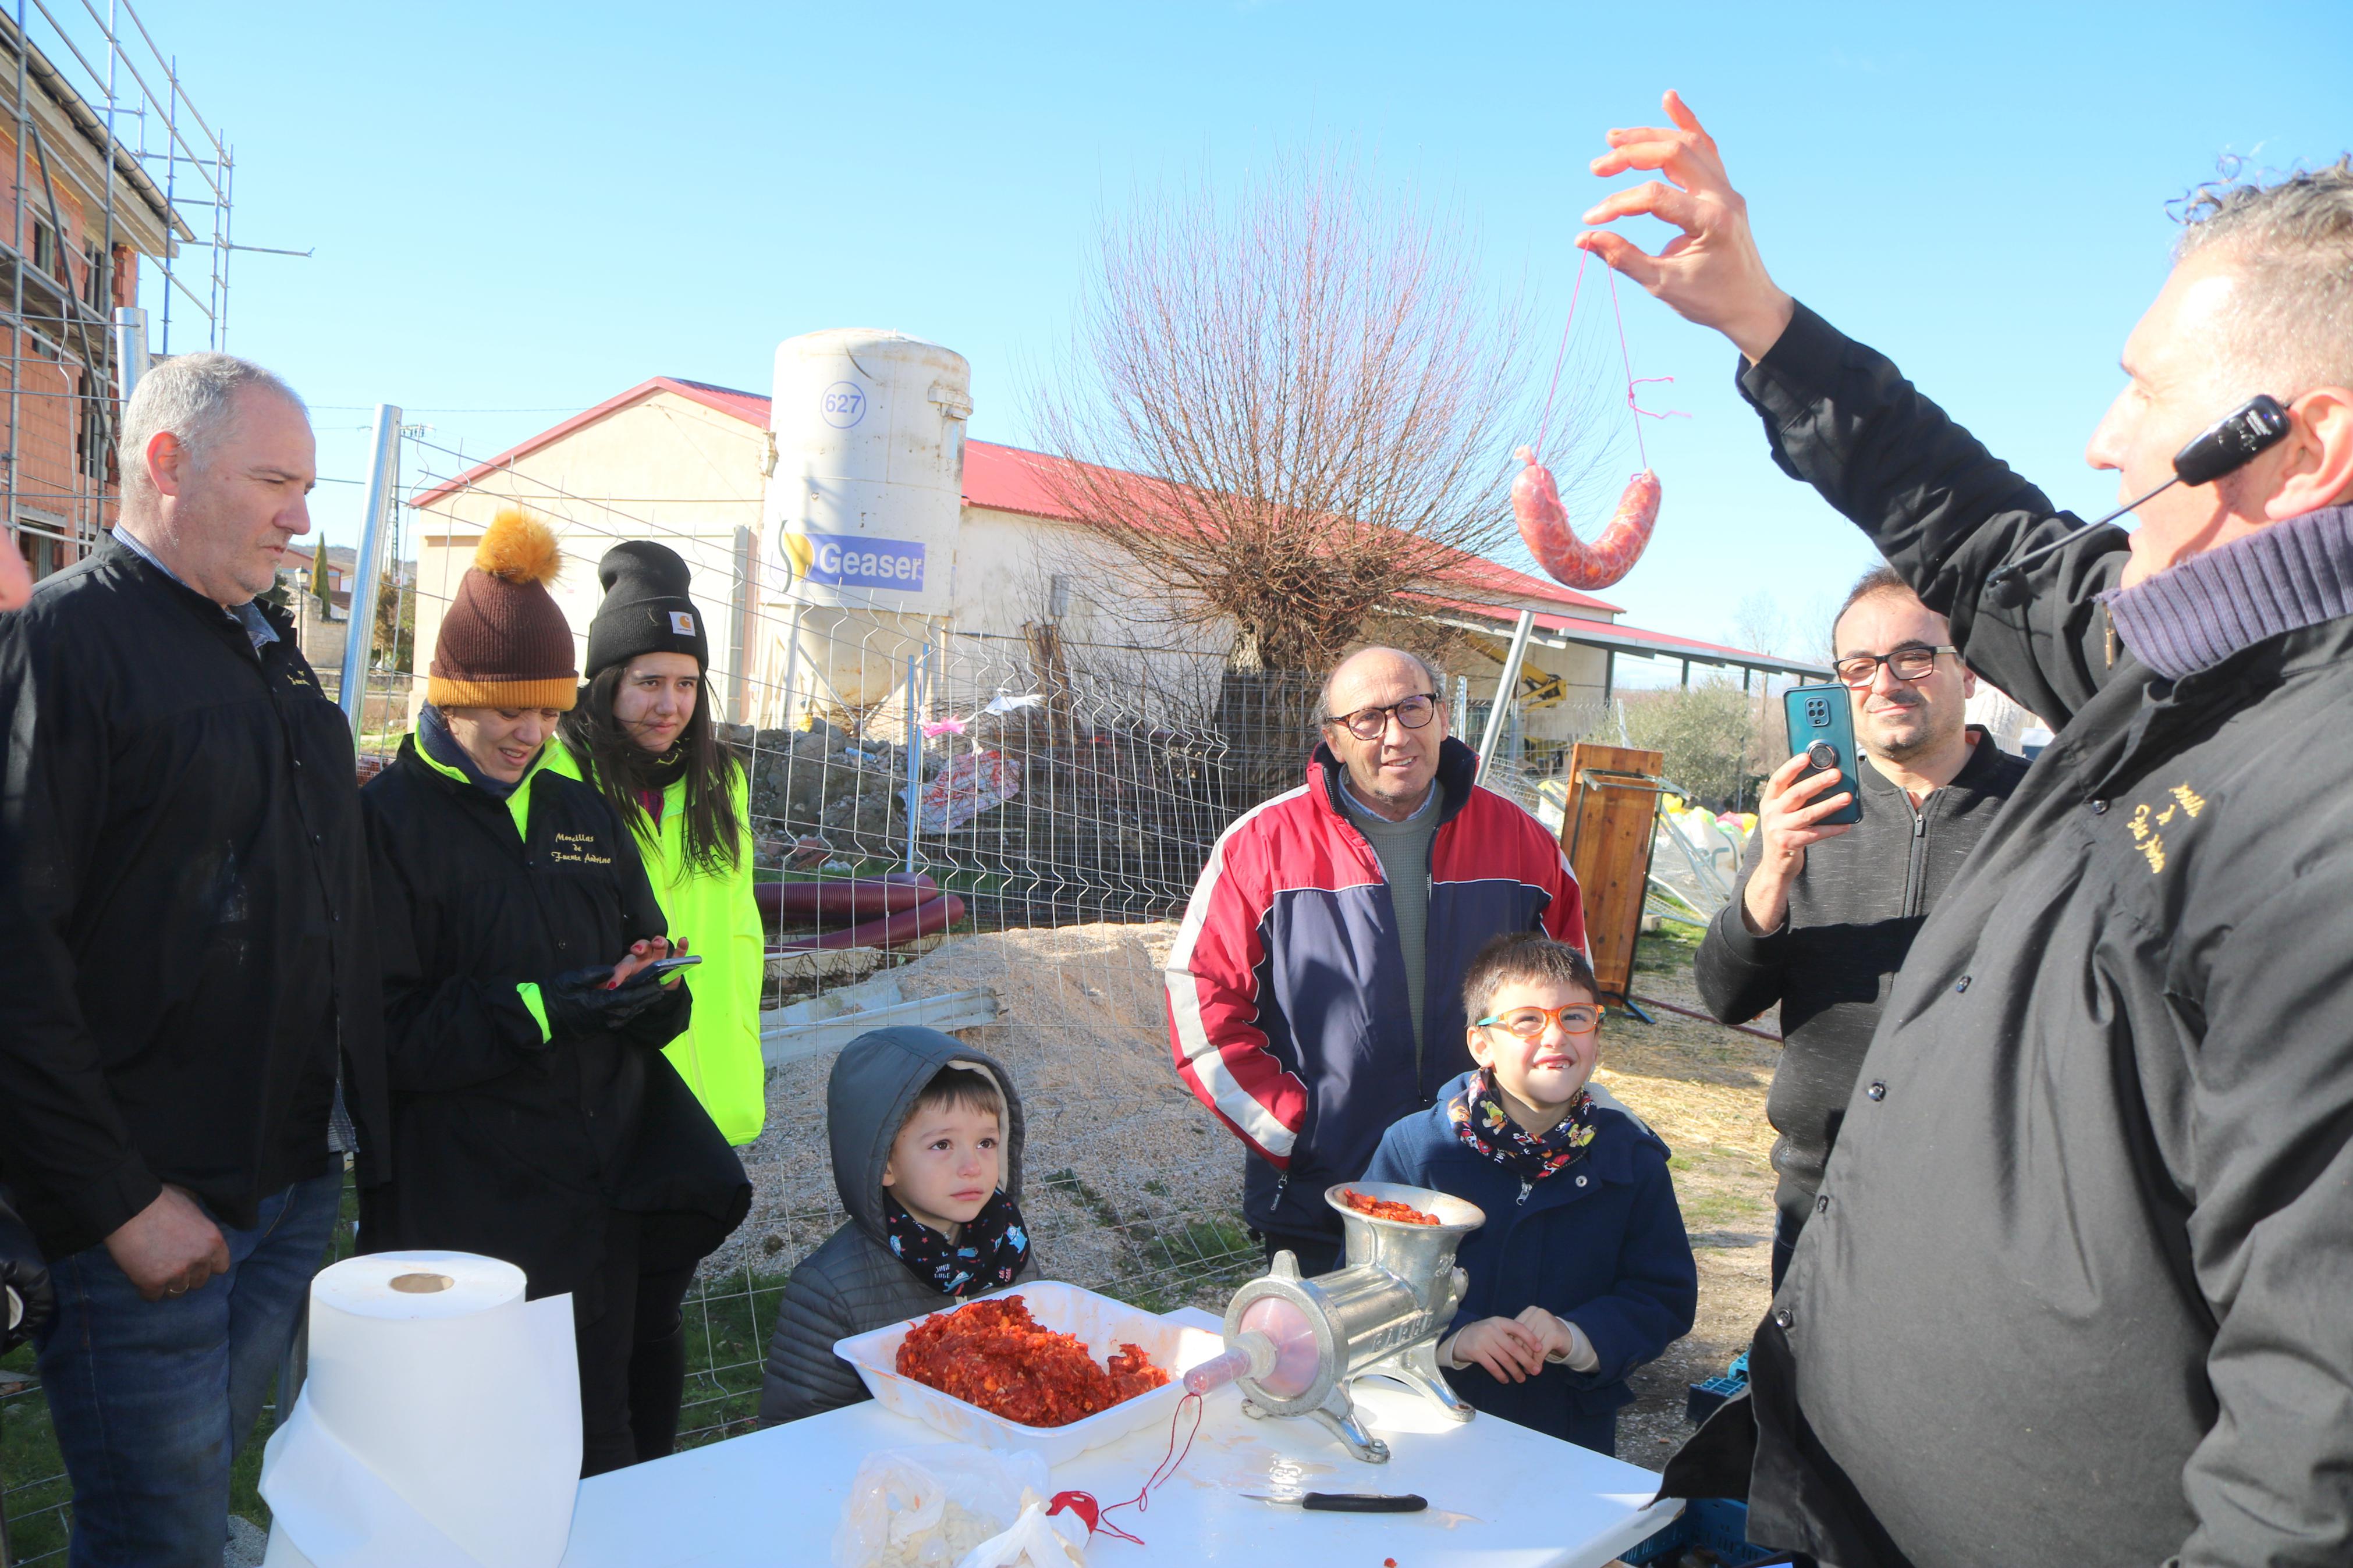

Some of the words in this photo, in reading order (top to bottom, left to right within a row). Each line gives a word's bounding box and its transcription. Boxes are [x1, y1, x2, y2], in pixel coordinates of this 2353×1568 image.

[826, 394, 861, 414] 627
[819, 542, 923, 581] Geaser
[572, 844, 582, 852] de
